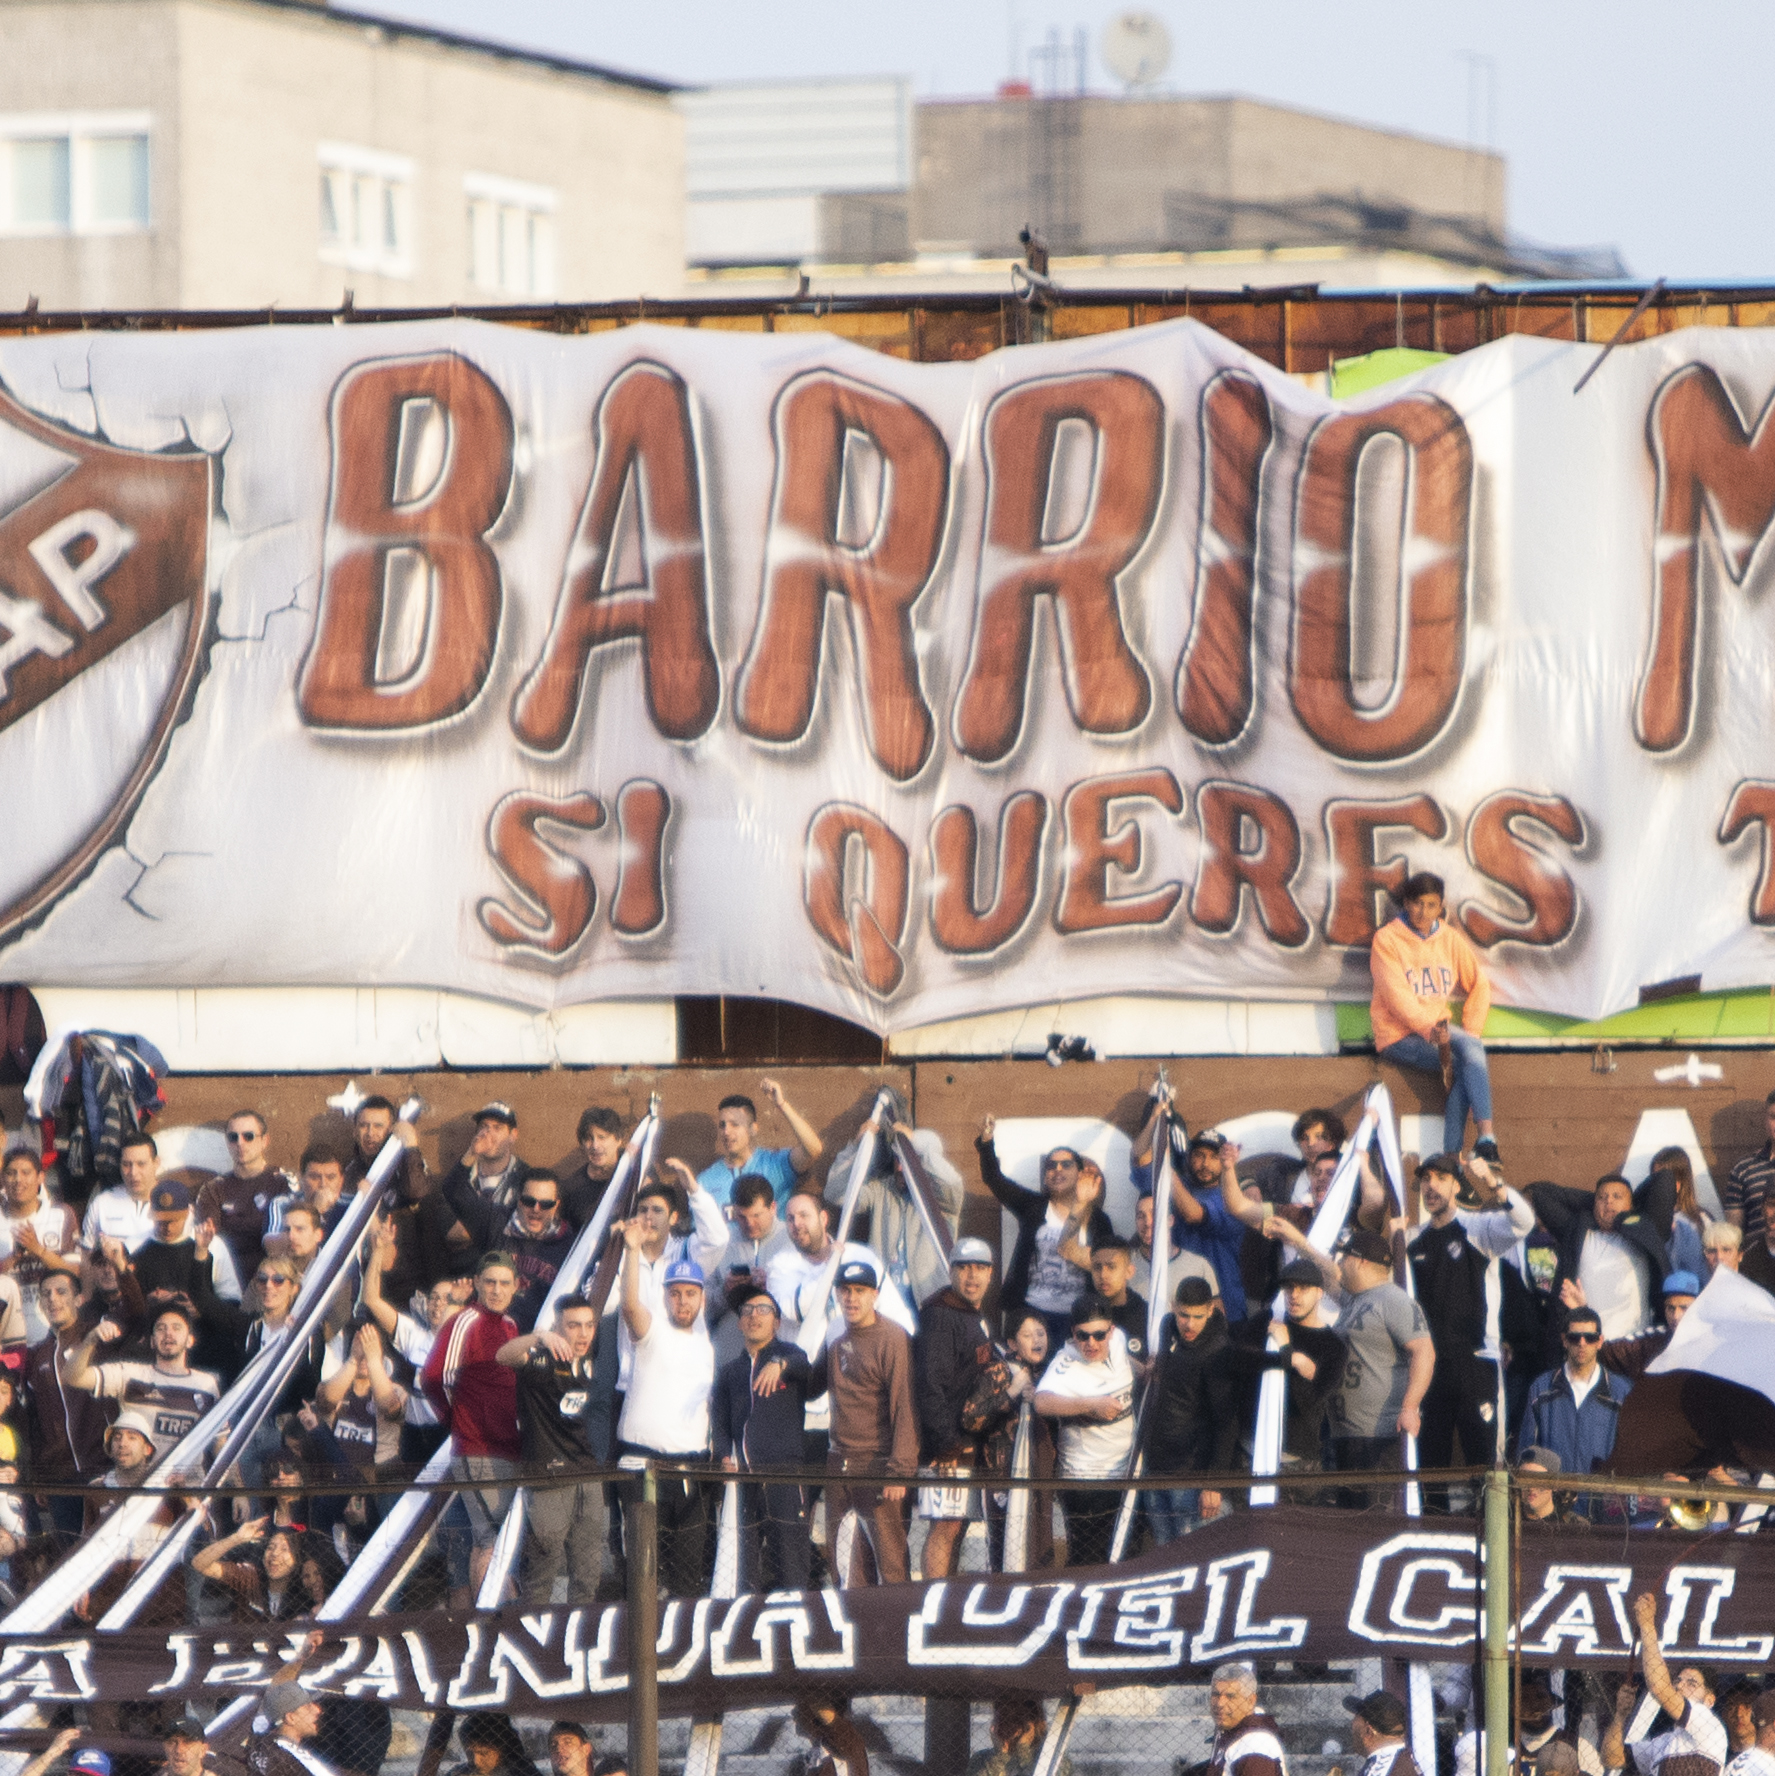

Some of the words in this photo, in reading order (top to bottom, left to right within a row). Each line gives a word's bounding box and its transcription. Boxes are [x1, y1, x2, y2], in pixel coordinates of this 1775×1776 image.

[295, 350, 1474, 785] BARRIO
[478, 780, 672, 957] SI
[804, 767, 1586, 998] QUERES
[908, 1551, 1308, 1669] DEL
